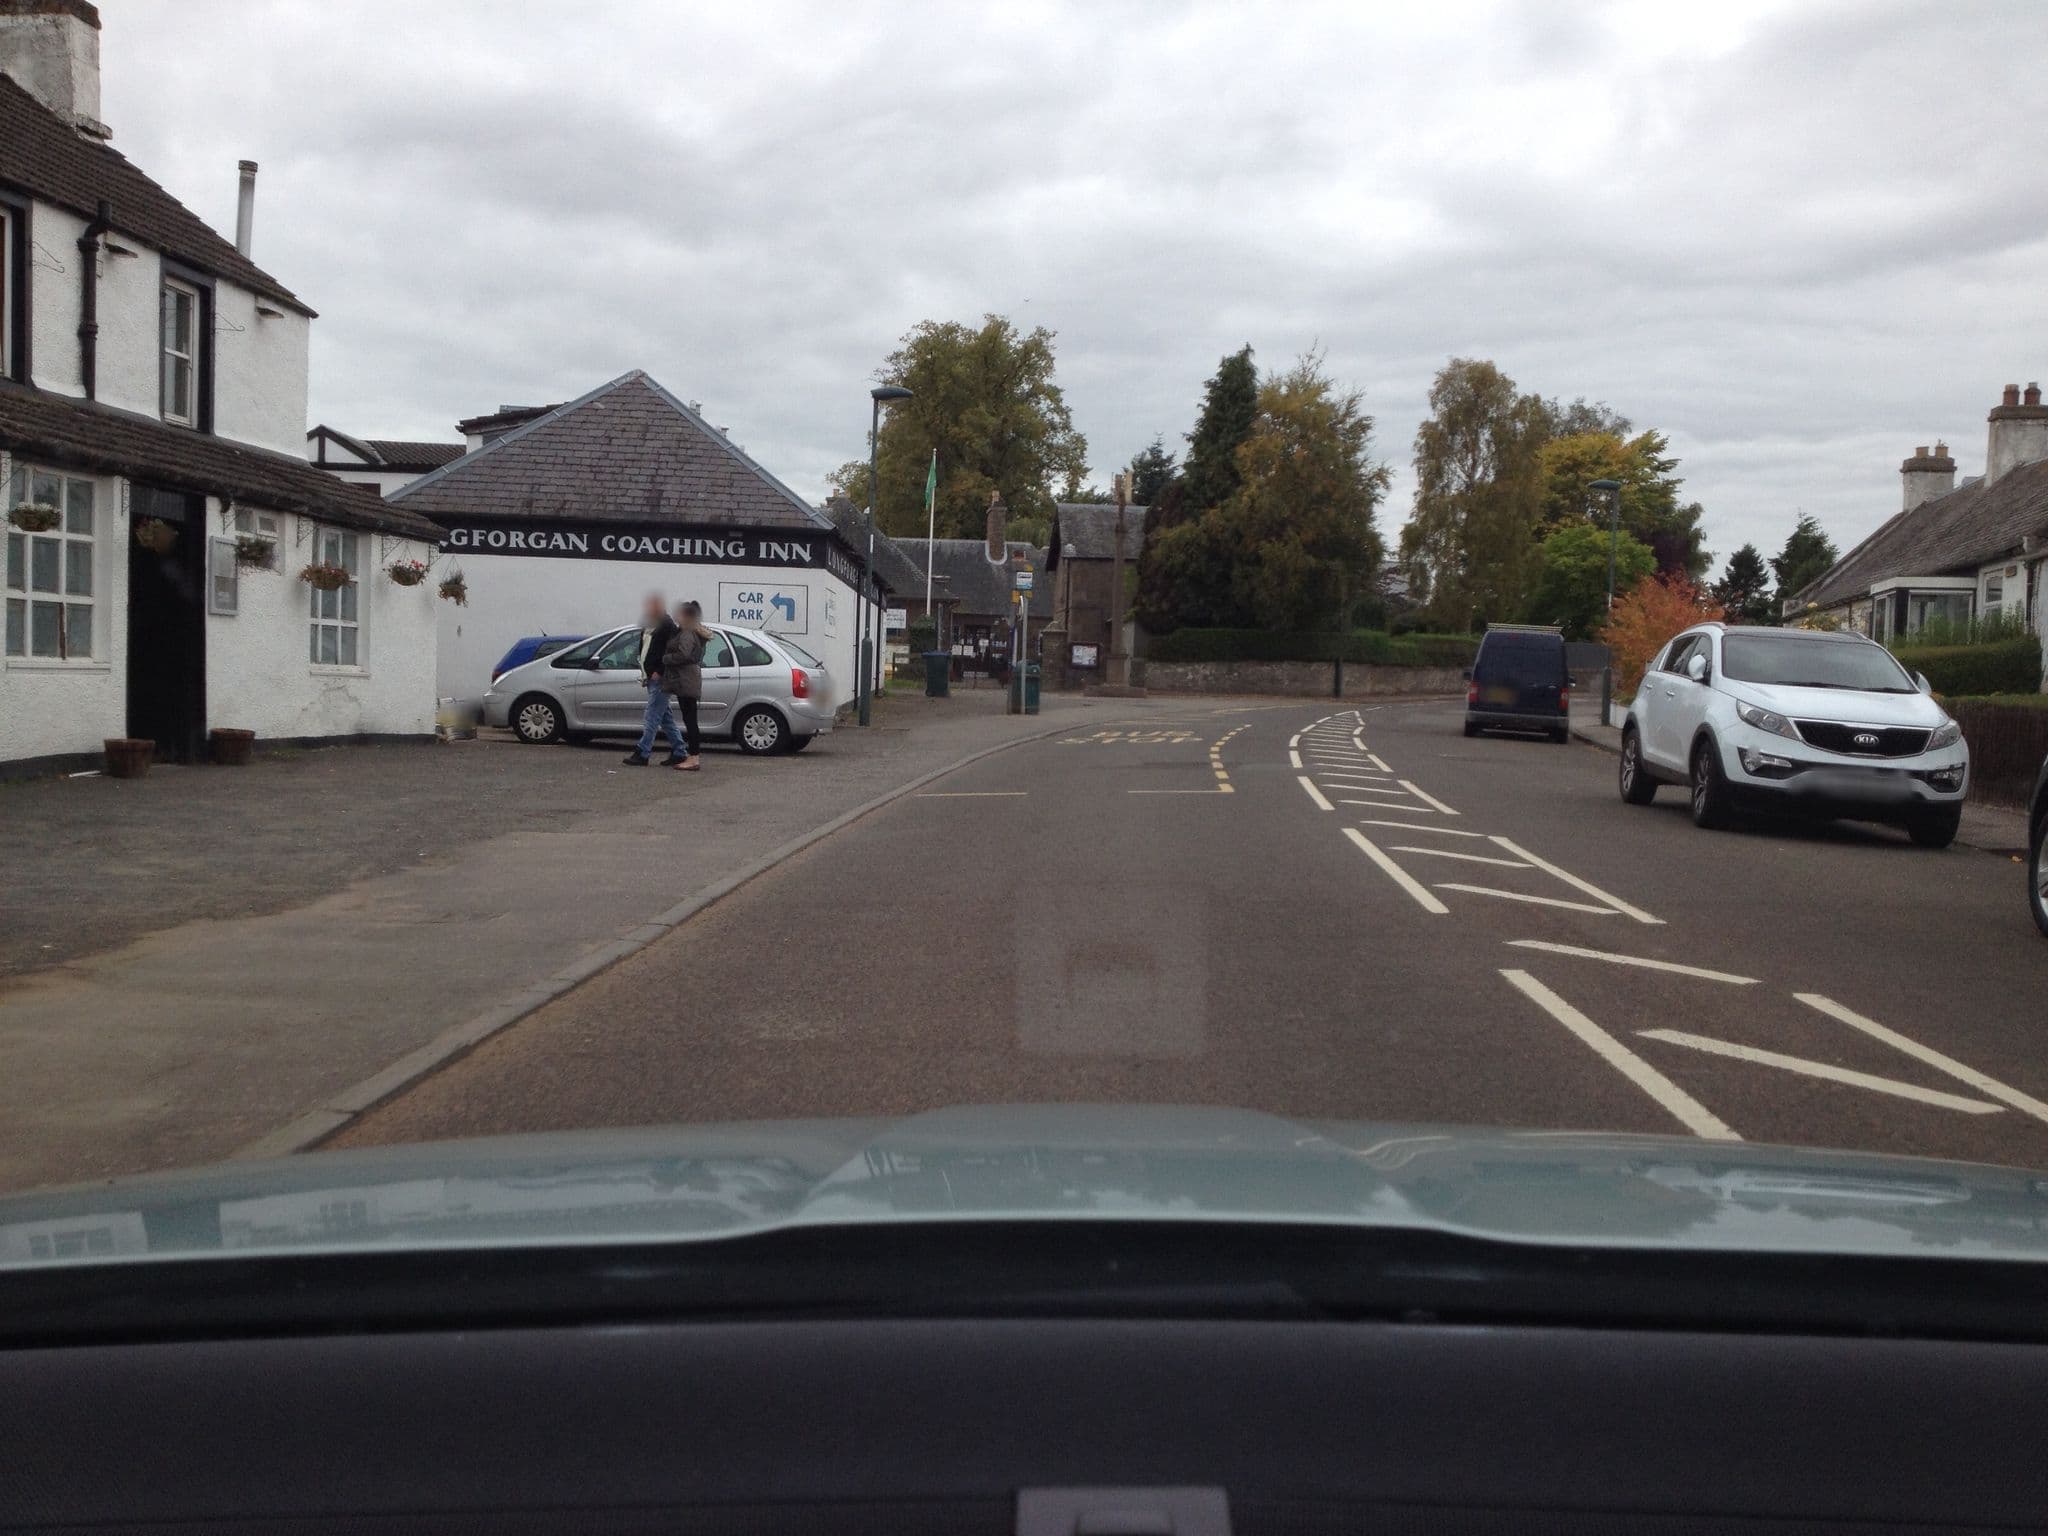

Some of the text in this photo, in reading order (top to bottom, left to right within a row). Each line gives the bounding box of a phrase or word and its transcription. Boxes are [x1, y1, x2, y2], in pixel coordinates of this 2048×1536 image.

[440, 528, 813, 563] GFORGAN COACHING INN
[737, 591, 764, 605] CAR
[730, 608, 764, 621] PARK
